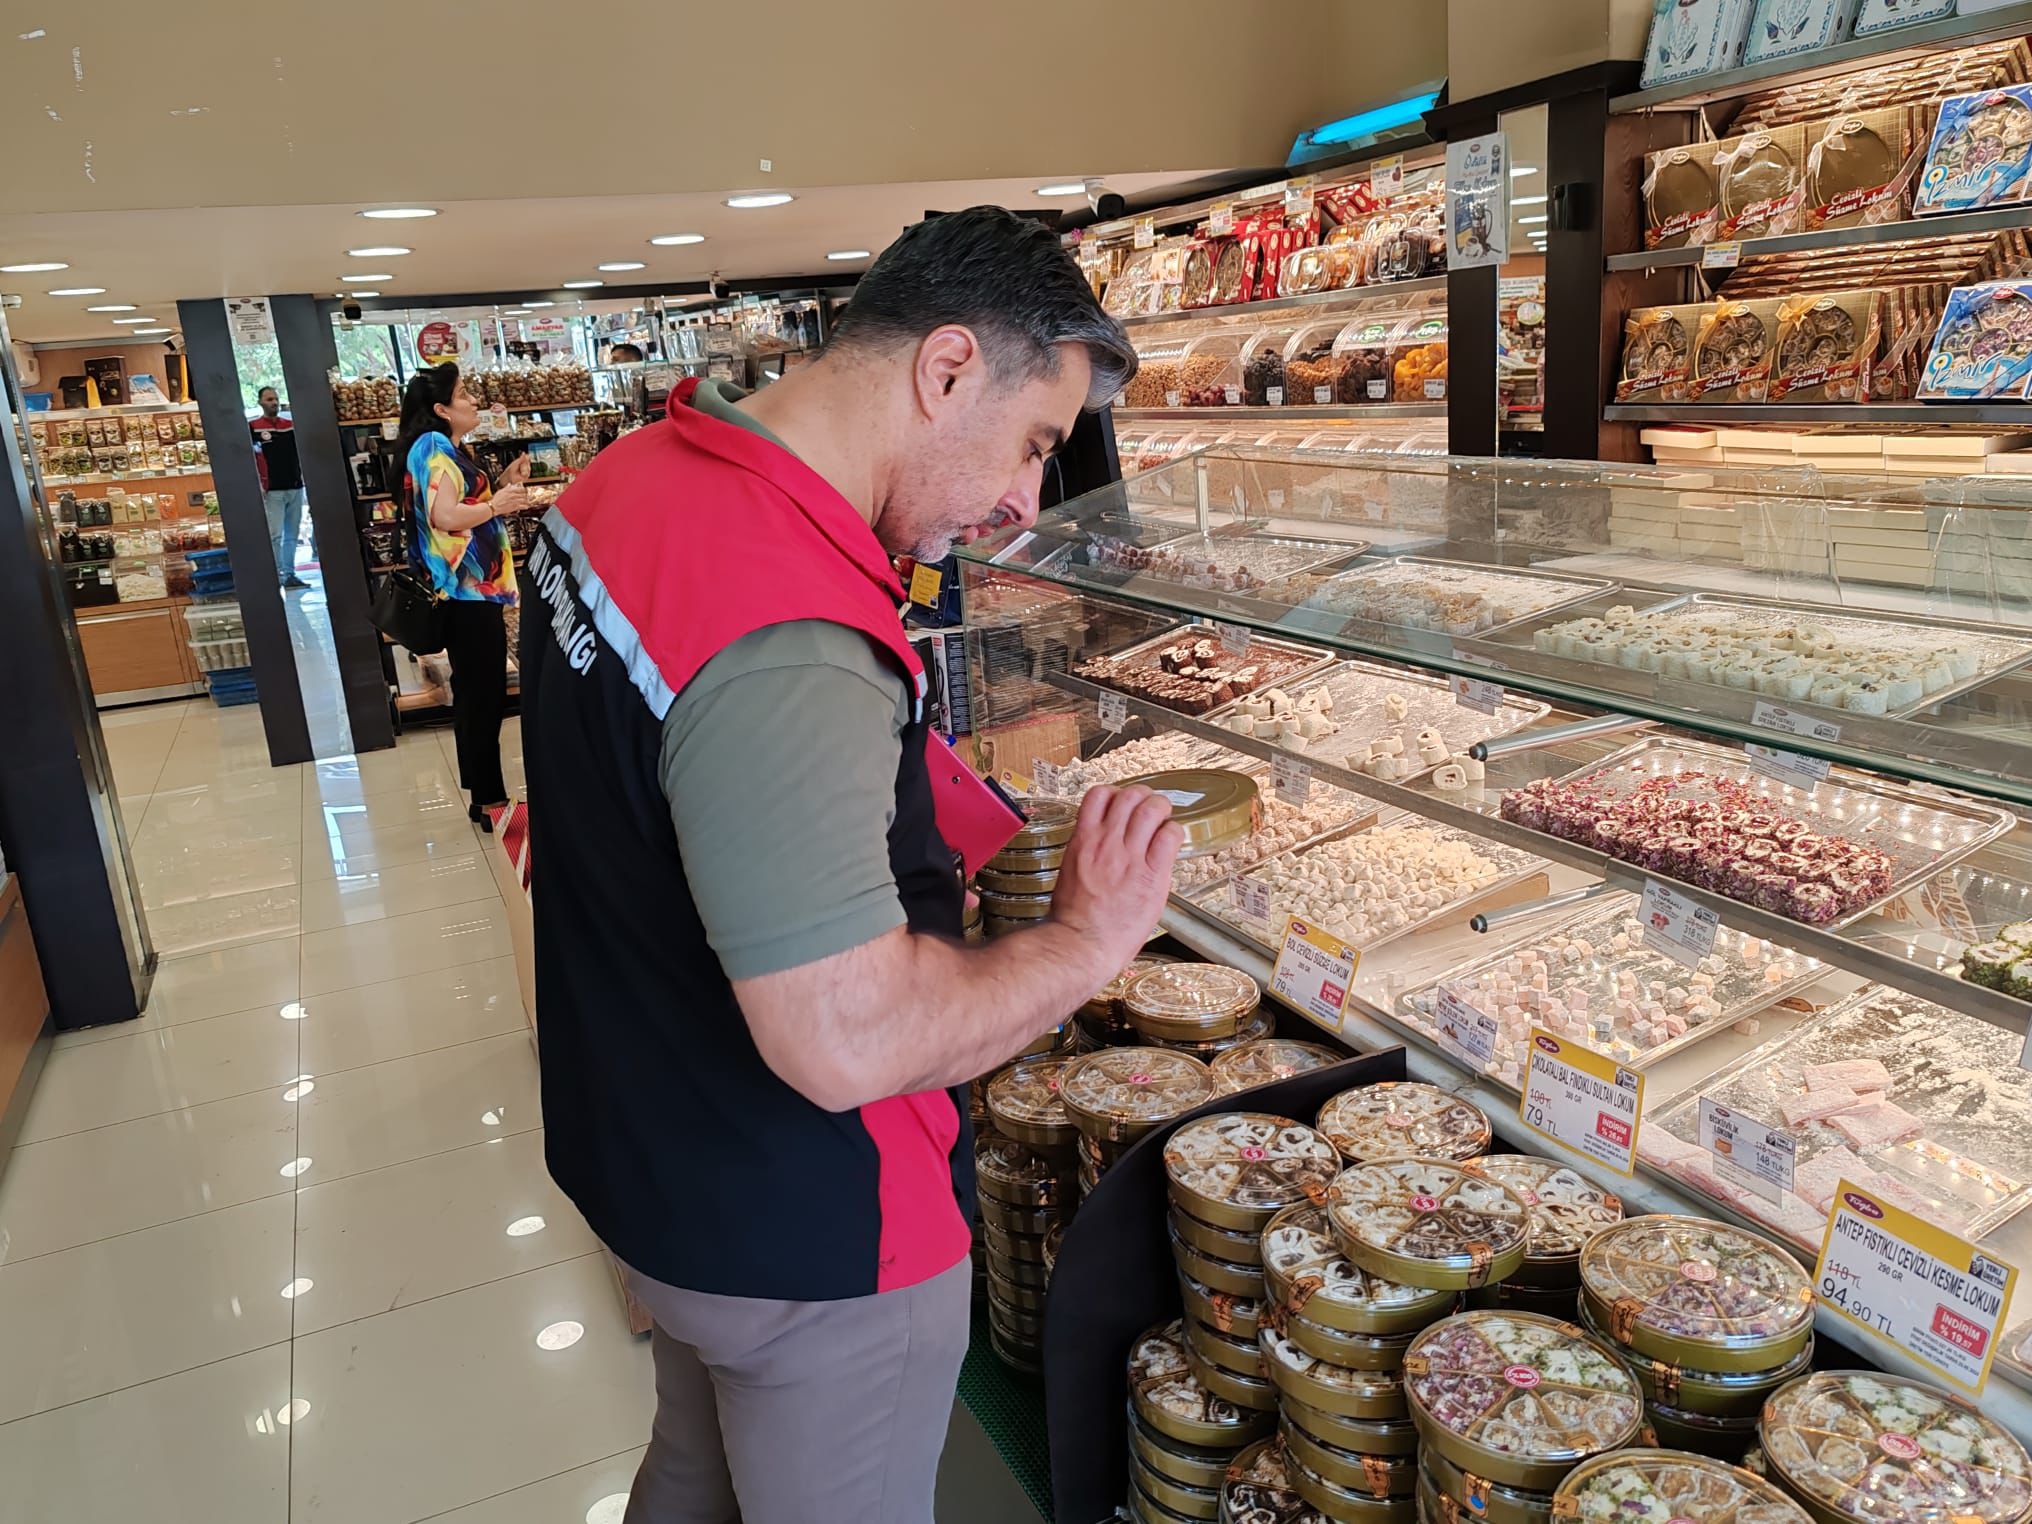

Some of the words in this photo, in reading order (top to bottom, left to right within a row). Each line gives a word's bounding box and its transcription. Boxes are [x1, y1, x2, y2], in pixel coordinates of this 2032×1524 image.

[1287, 937, 1296, 952] BOL
[1330, 959, 1350, 980] LOKUM
[1275, 978, 1286, 992] 79
[1531, 1052, 1558, 1080] ÇİKOLATALI
[1557, 1066, 1569, 1088] BAL
[1568, 1071, 1593, 1097] FINDIKLI
[1592, 1081, 1614, 1105] SULTAN
[1613, 1090, 1635, 1115] LOKUM
[1526, 1103, 1543, 1127] 79
[1546, 1119, 1559, 1138] TL
[1708, 1113, 1739, 1135] BİSKÜVİLİK
[1713, 1125, 1733, 1140] LOKUM
[1756, 1151, 1770, 1166] 148
[1834, 1213, 1864, 1242] ANTEP
[1862, 1225, 1899, 1264] FISTIKLI
[1897, 1242, 1935, 1283] CEVİZLİ
[1930, 1264, 1964, 1299] KESME
[1963, 1281, 2001, 1318] LOKUM
[1877, 1261, 1891, 1276] 290
[1891, 1268, 1904, 1283] GR
[1851, 1274, 1862, 1290] TL
[1821, 1277, 1872, 1322] 94,90
[1876, 1312, 1895, 1339] TL
[1939, 1324, 1949, 1338] %
[1940, 1310, 1981, 1341] İNDİRİM
